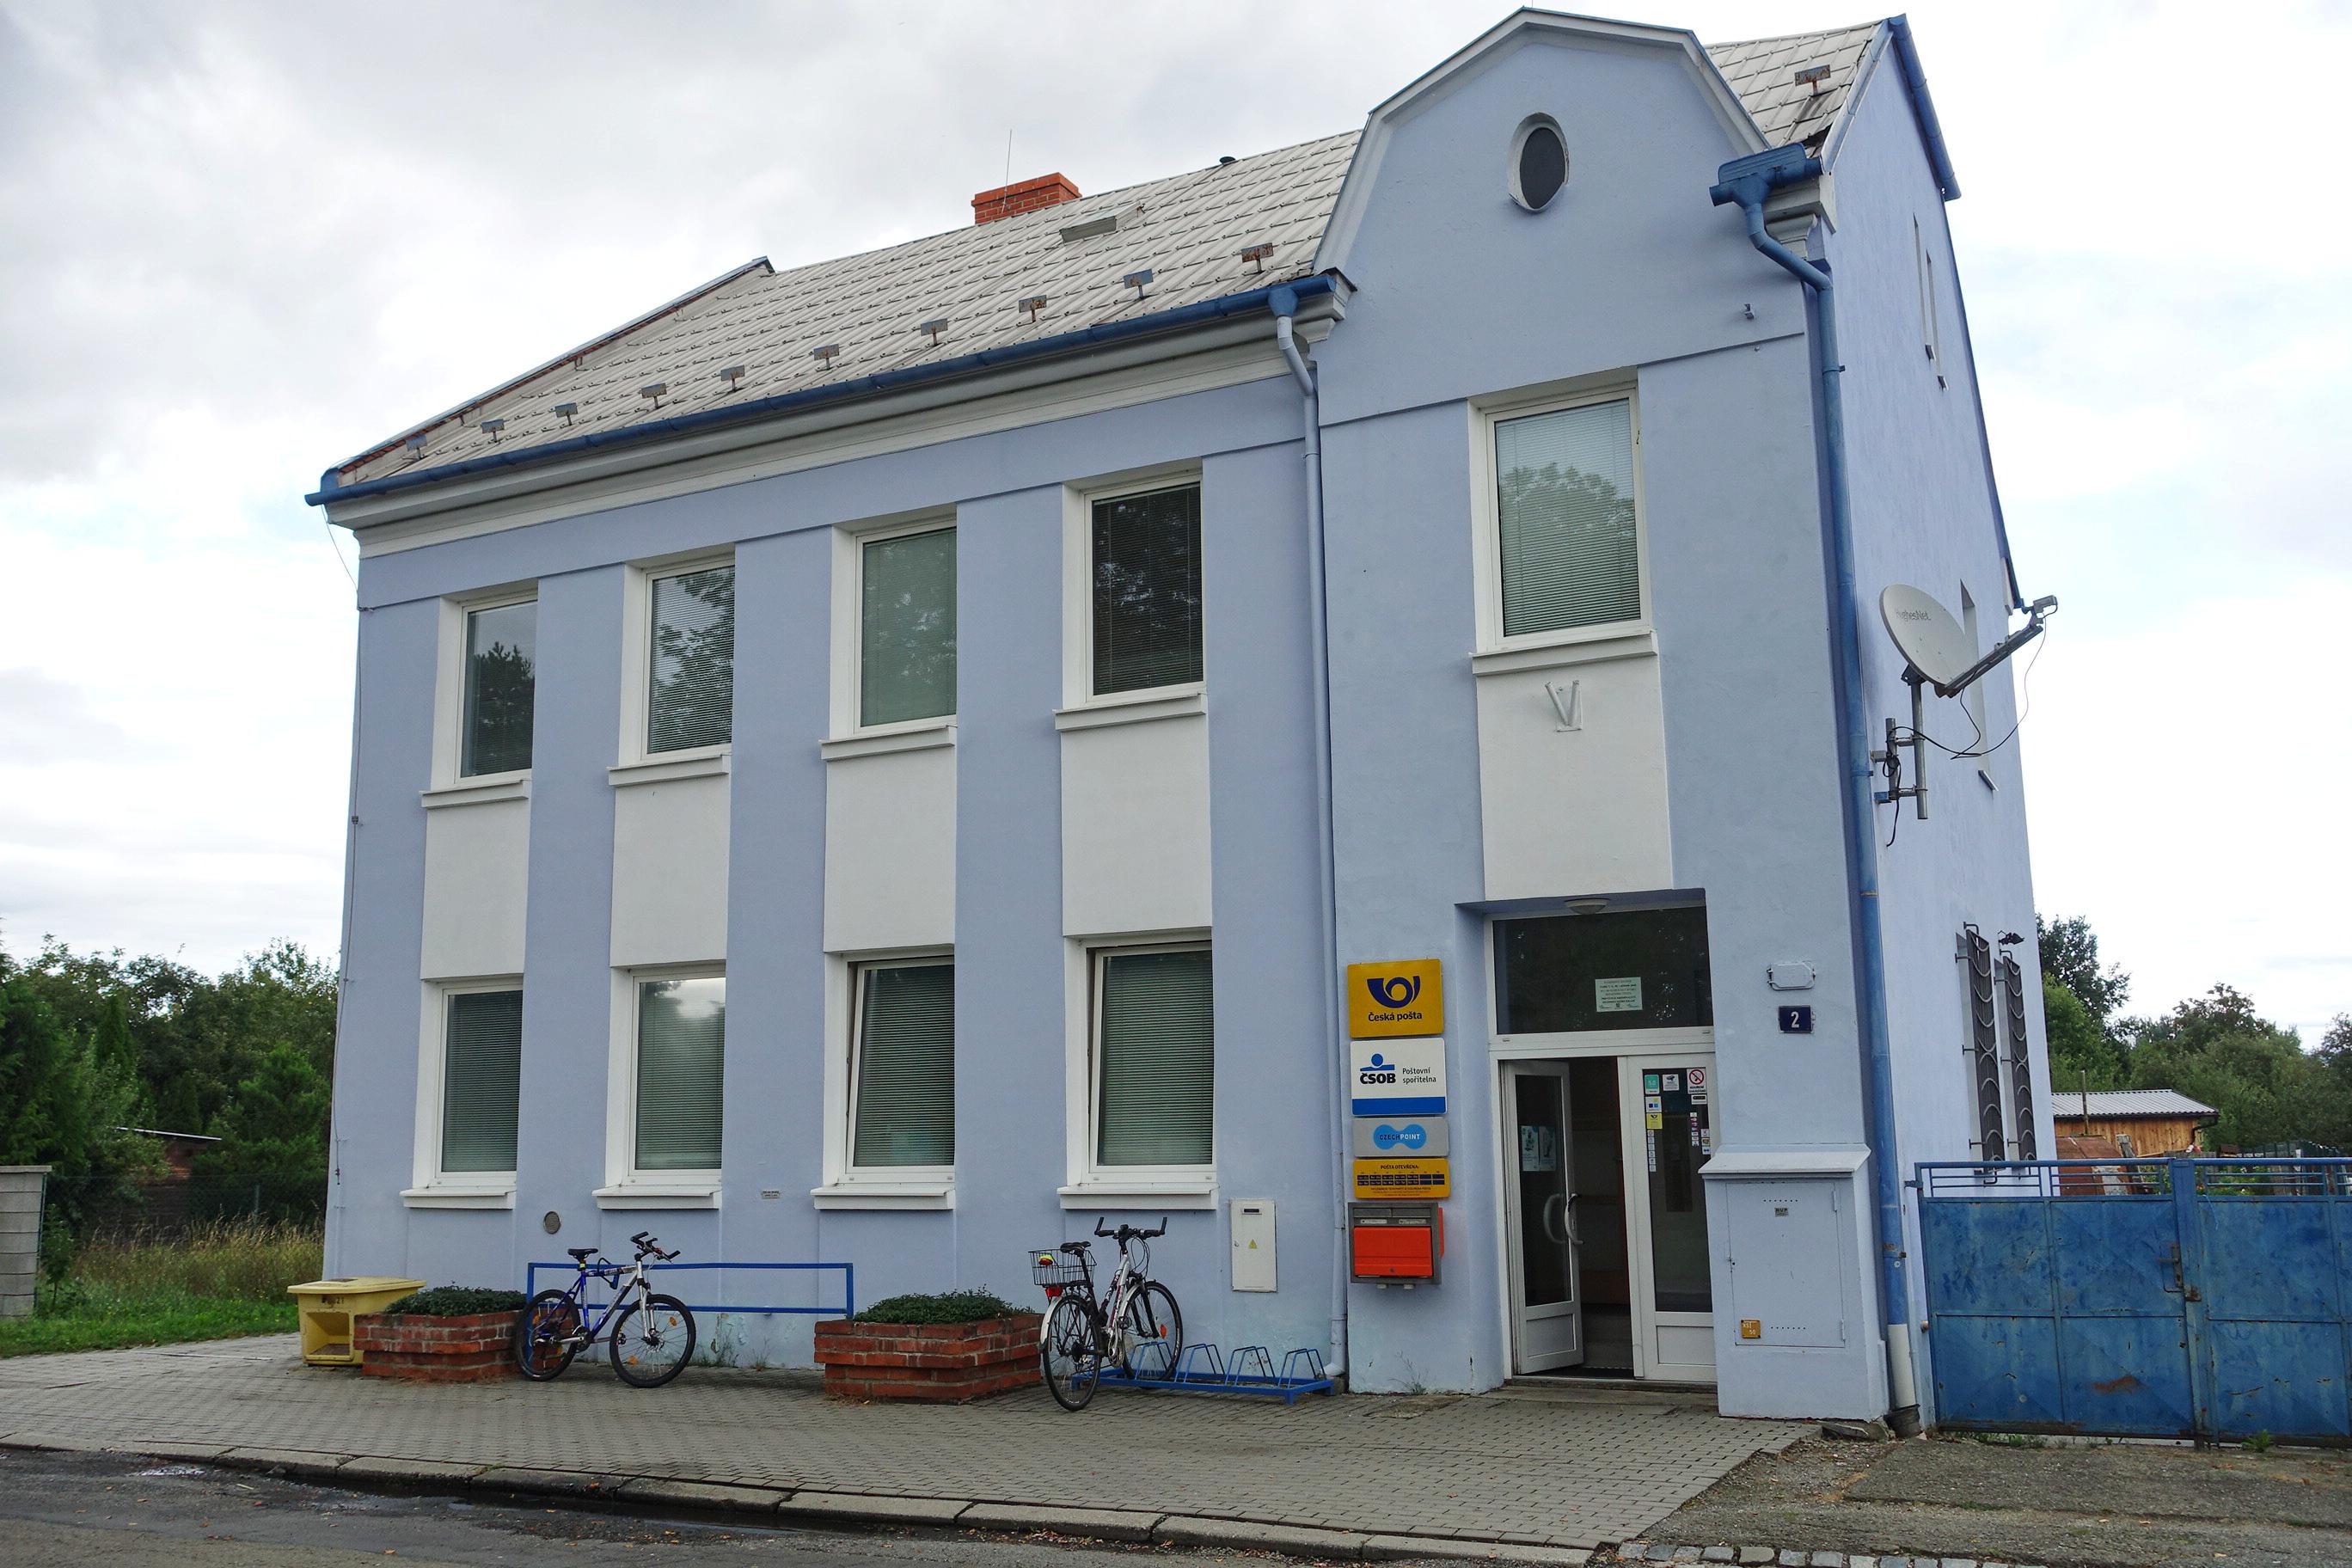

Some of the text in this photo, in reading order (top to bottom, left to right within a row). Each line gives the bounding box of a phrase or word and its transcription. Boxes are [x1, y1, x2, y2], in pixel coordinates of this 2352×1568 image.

[1369, 1011, 1422, 1021] Česká pošta
[1791, 1011, 1800, 1028] 2
[1360, 1073, 1396, 1084] ČSOB
[1402, 1075, 1436, 1085] spořitelna
